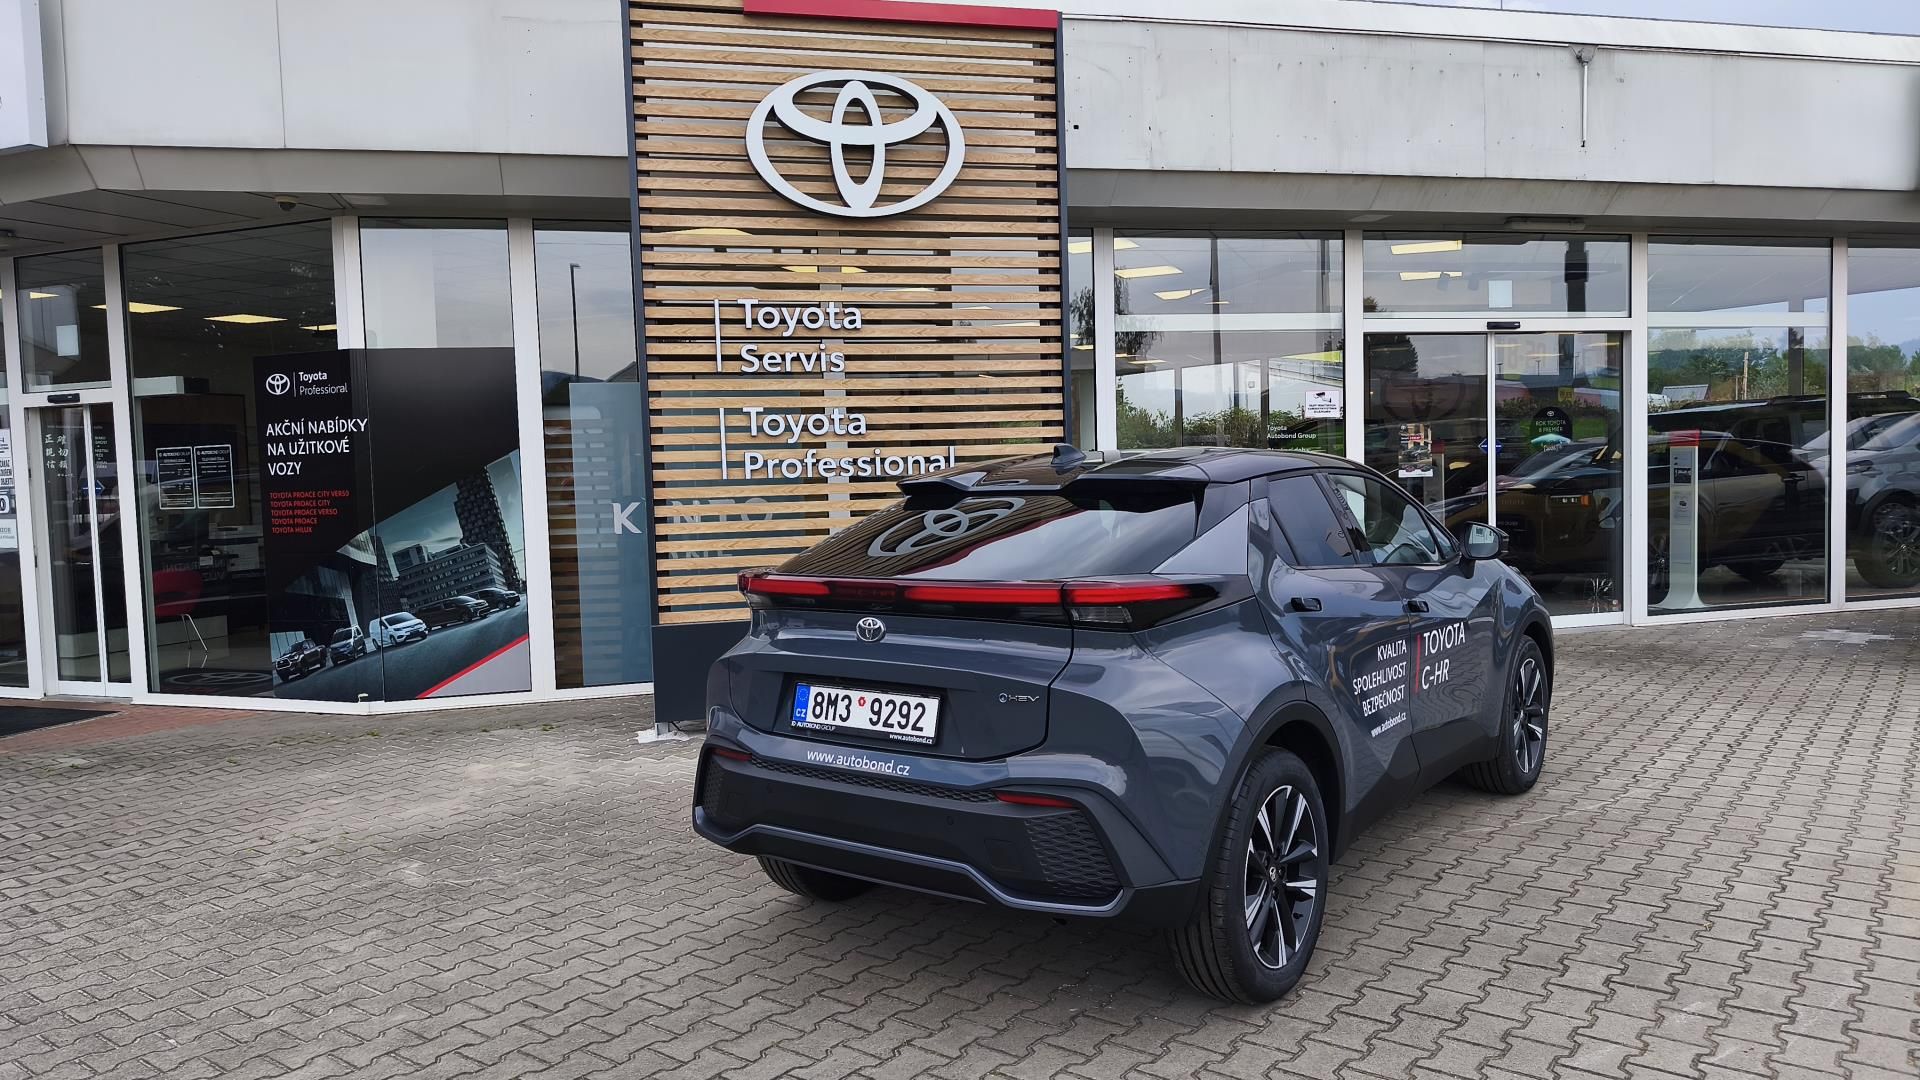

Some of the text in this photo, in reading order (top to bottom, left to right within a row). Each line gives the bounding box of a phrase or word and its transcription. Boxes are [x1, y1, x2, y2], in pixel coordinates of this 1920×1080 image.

[737, 298, 862, 336] Toyota
[740, 343, 846, 372] Servis
[298, 371, 328, 382] Toyota
[299, 383, 348, 396] Professional
[266, 416, 367, 437] AKČNÍ NABÍDKY
[742, 407, 867, 444] Toyota
[1267, 424, 1287, 432] Toyota
[1298, 432, 1317, 440] Group
[268, 436, 350, 456] NA UŽITKOVÉ
[268, 462, 302, 476] VOZY
[744, 445, 956, 480] Professional
[1377, 640, 1407, 662] KVALITA
[1424, 622, 1465, 656] TOYOTA
[1352, 661, 1407, 696] SPOLEHLIVOST
[1421, 658, 1450, 690] C-HR
[795, 708, 806, 717] CZ
[812, 692, 926, 732] 8M3 9292
[1362, 684, 1406, 717] BEZPEČNOST
[1371, 711, 1406, 738] www.autobond.cz
[889, 733, 933, 744] www.autobond.cz
[807, 750, 910, 776] www.autobond.cz
